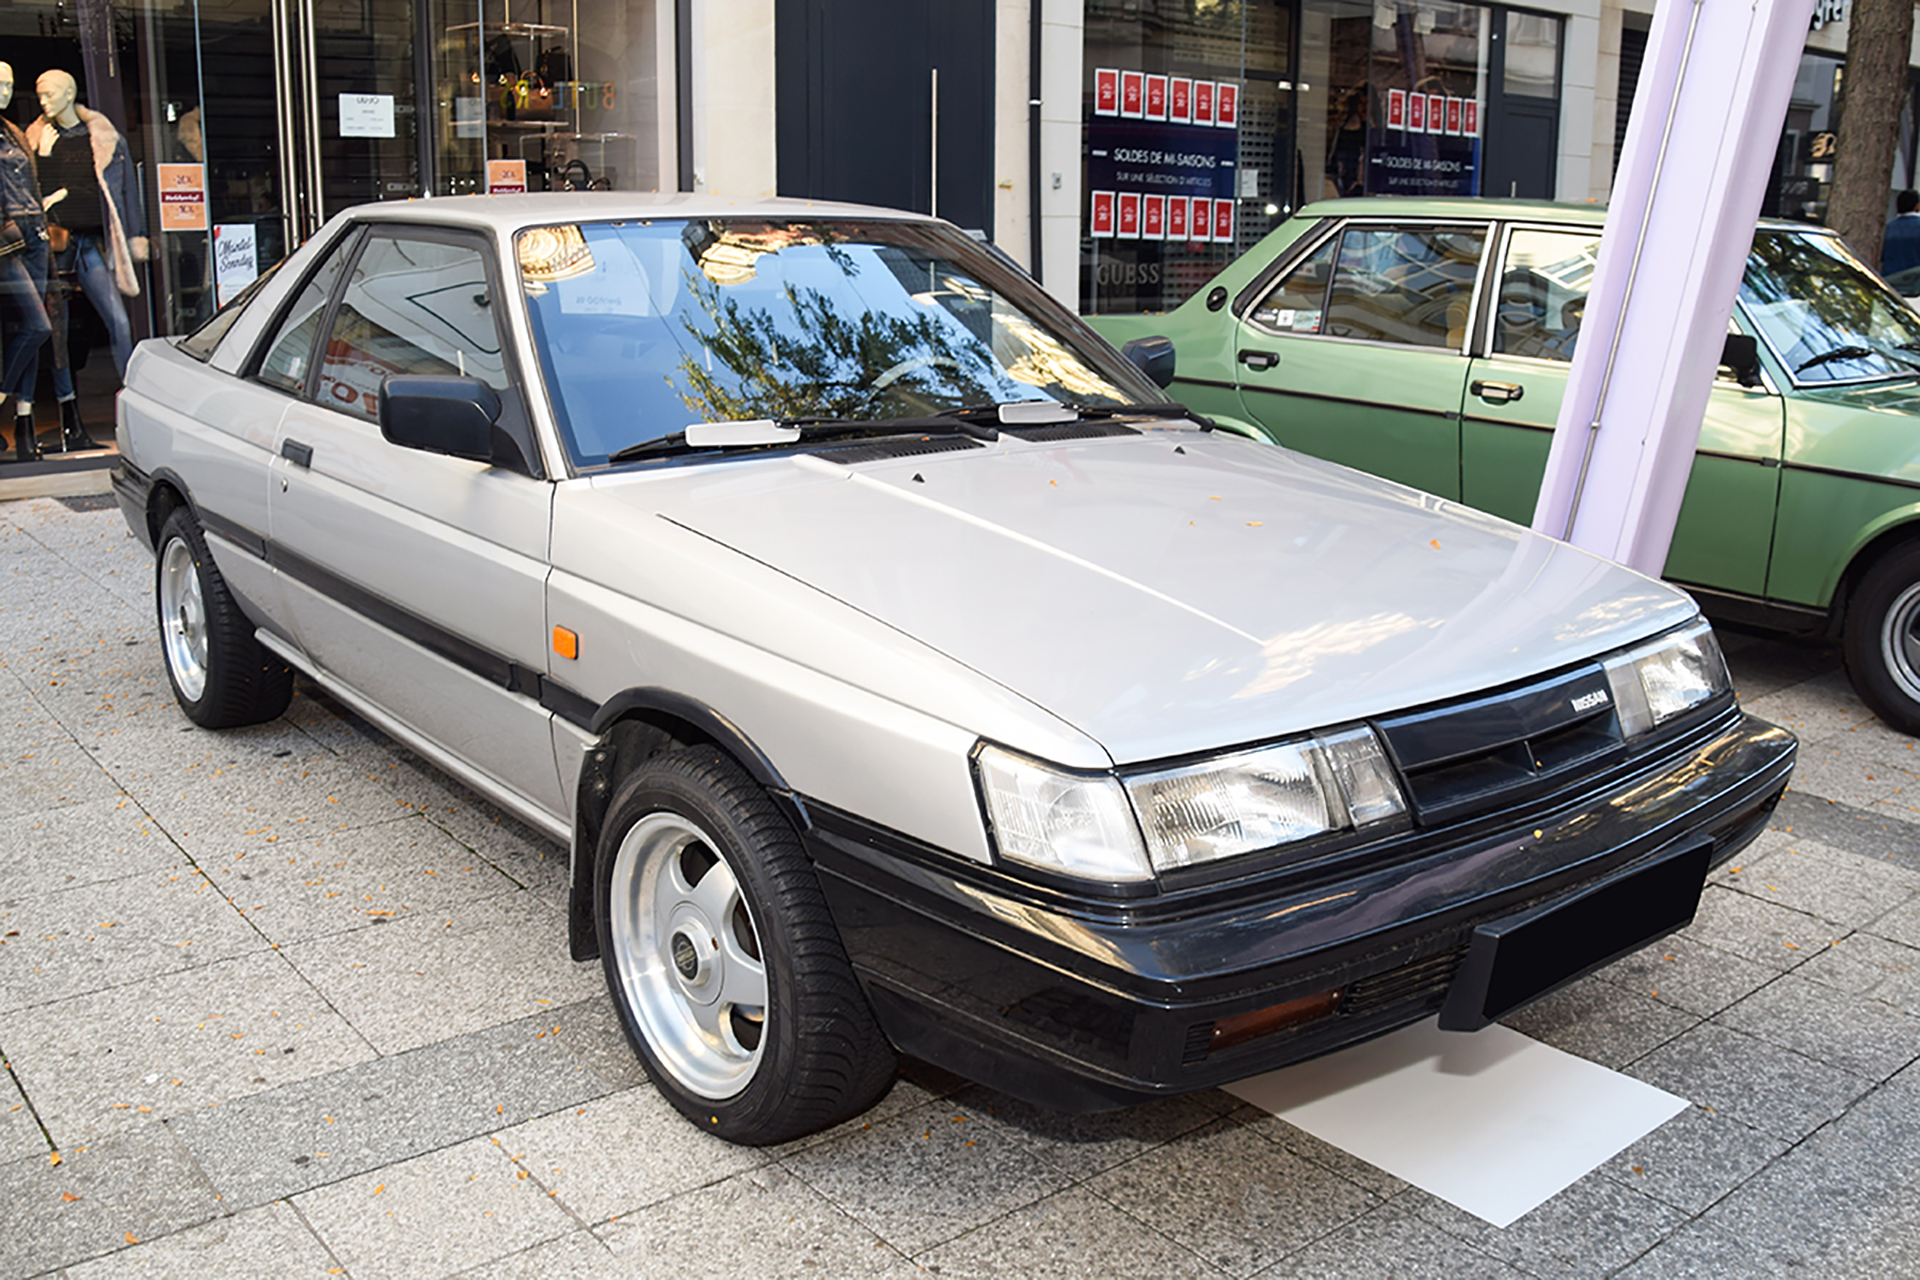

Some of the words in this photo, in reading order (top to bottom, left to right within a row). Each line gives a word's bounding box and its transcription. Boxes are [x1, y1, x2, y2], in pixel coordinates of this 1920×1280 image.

[1114, 148, 1149, 162] SOLDES
[1150, 151, 1162, 164] DE
[1096, 262, 1160, 285] GUESS
[1571, 689, 1608, 712] NISSAN
